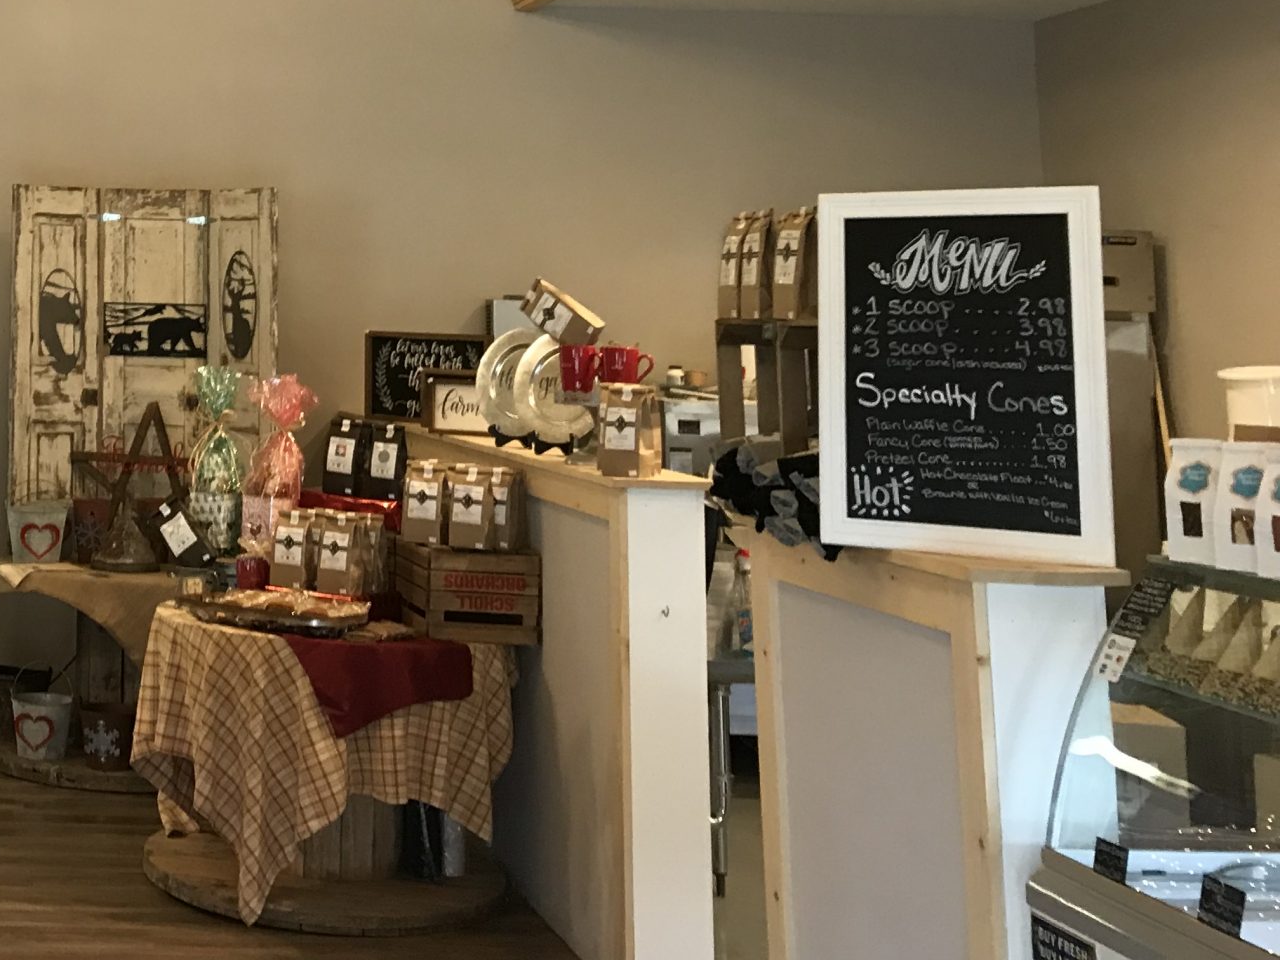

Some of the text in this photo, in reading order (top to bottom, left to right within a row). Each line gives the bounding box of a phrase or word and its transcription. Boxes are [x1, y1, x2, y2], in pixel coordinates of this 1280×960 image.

[865, 296, 881, 315] 1
[864, 318, 880, 336] 2
[864, 339, 880, 358] 3
[855, 372, 1069, 420] Specialty Cones
[443, 573, 527, 592] ORCHARDS
[456, 594, 515, 613] SCHOLL
[1037, 926, 1088, 960] BUY FRESH
